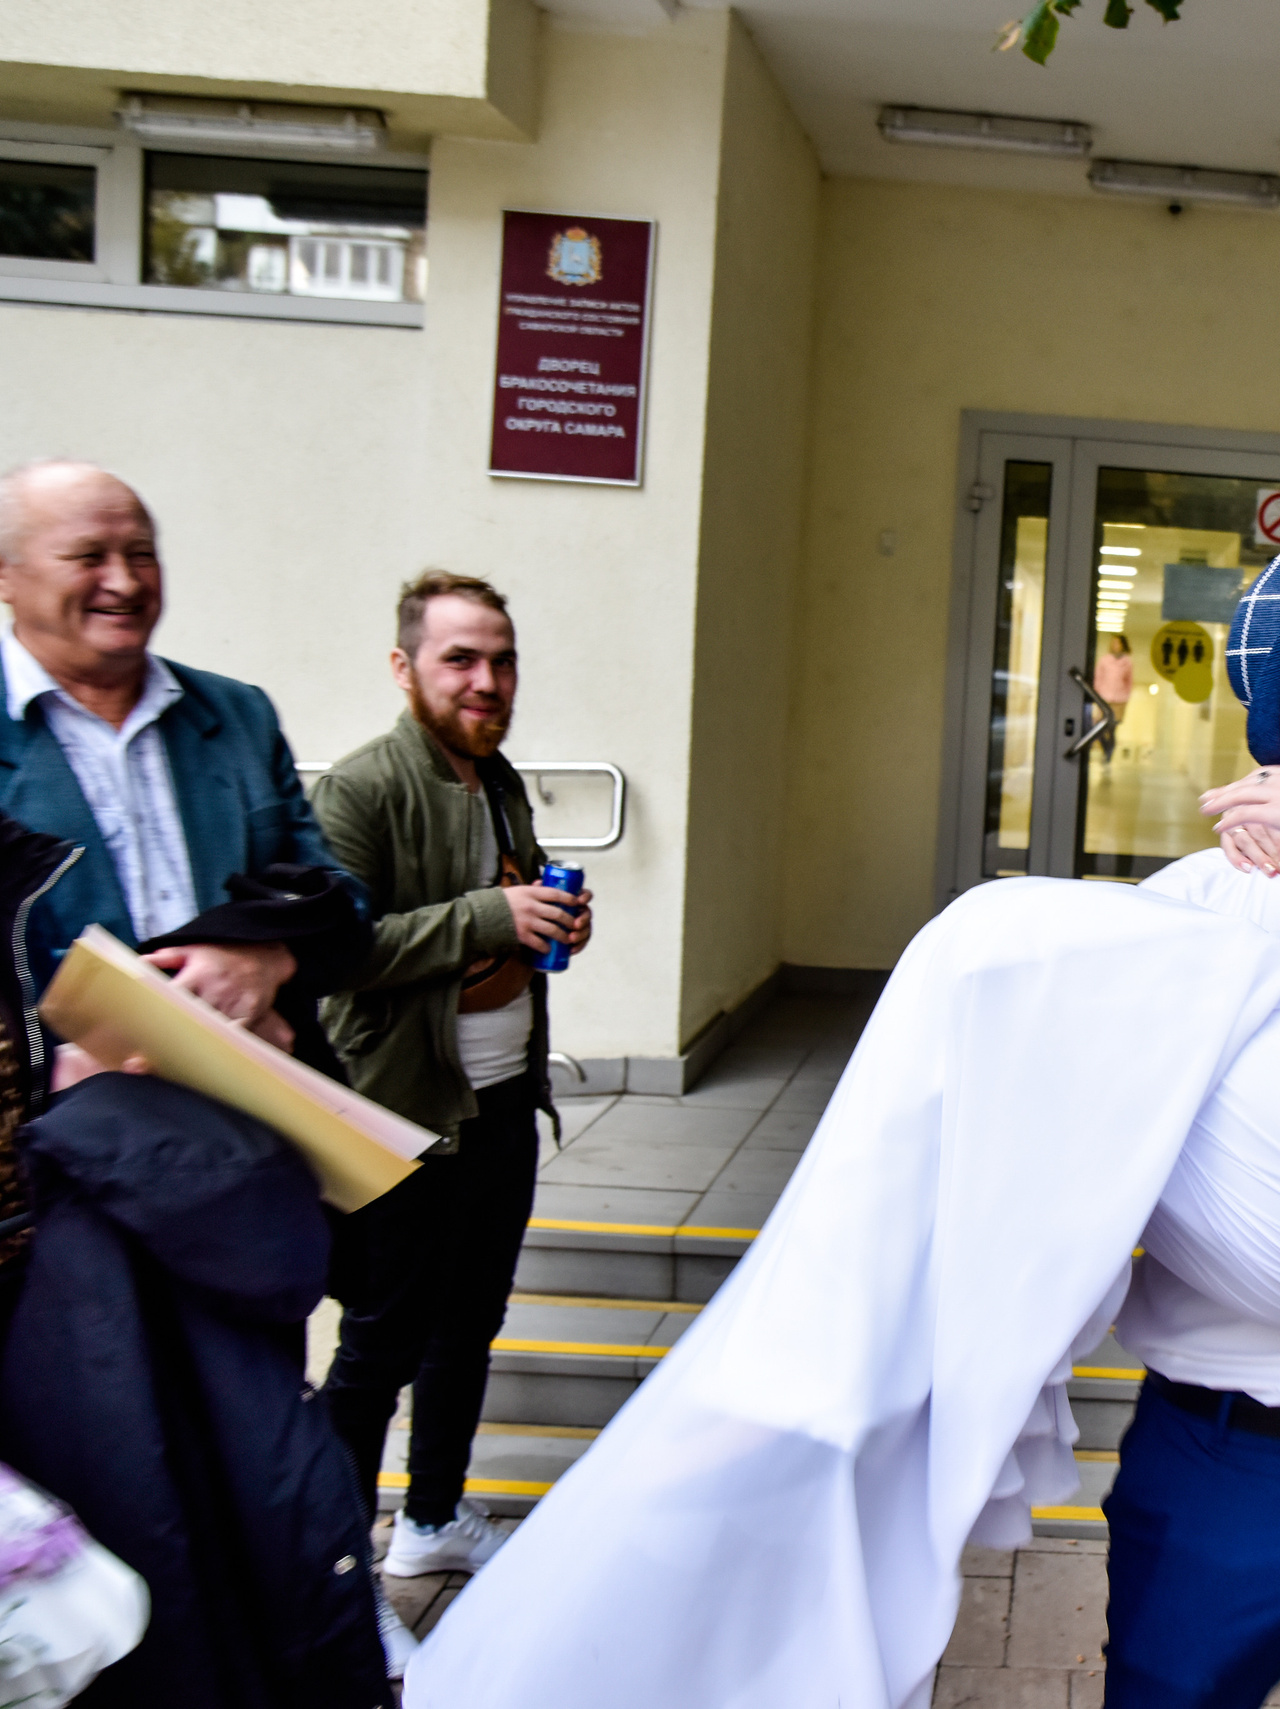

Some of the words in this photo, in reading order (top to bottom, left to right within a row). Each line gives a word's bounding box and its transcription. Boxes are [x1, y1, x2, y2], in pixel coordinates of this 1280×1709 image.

[538, 357, 601, 375] ДВОРЕЦ
[499, 375, 637, 397] БРАКОСОЧЕТАНИЯ
[517, 397, 617, 417] ГОРОДСКОГО
[505, 417, 562, 433] ОКРУГА
[564, 421, 626, 438] САМАРА
